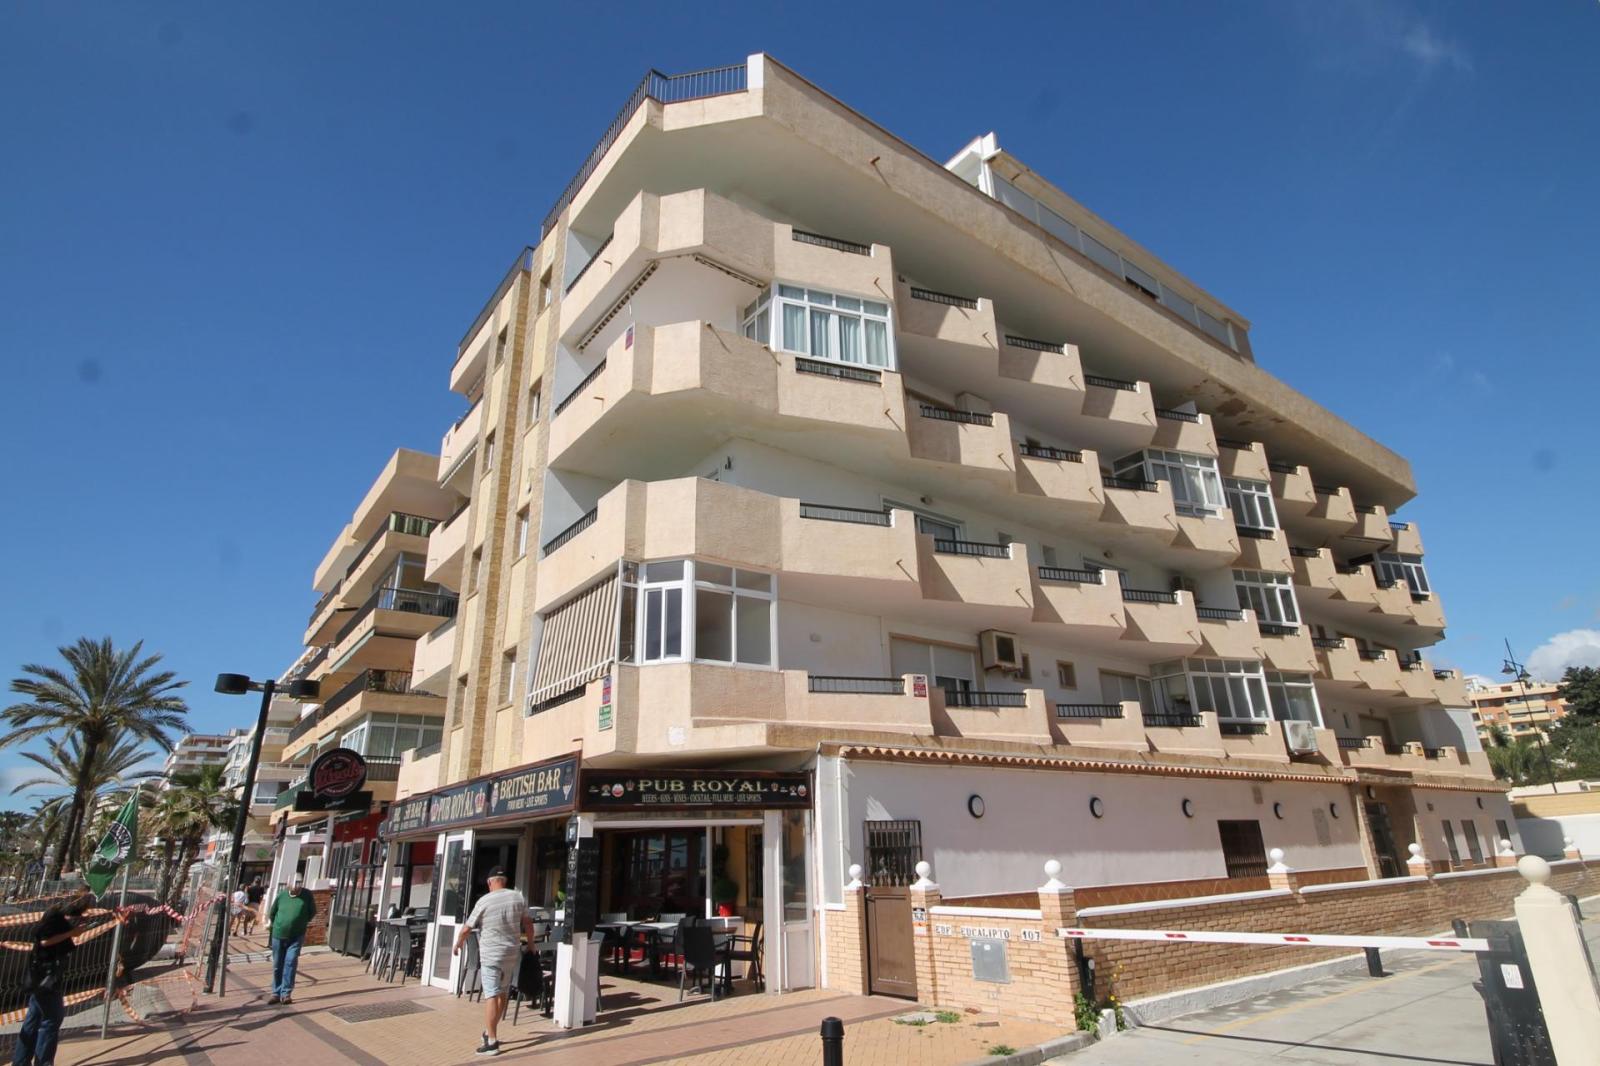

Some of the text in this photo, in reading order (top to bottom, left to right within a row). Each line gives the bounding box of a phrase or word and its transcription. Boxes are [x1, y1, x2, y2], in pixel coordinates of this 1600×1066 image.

[500, 773, 536, 800] BRITISH
[537, 768, 561, 793] BAR
[639, 779, 686, 792] PUB
[692, 778, 768, 792] ROYAL
[439, 787, 474, 821] PUB ROYAL
[960, 927, 1010, 938] EUCALIPTO
[1022, 930, 1040, 940] 107
